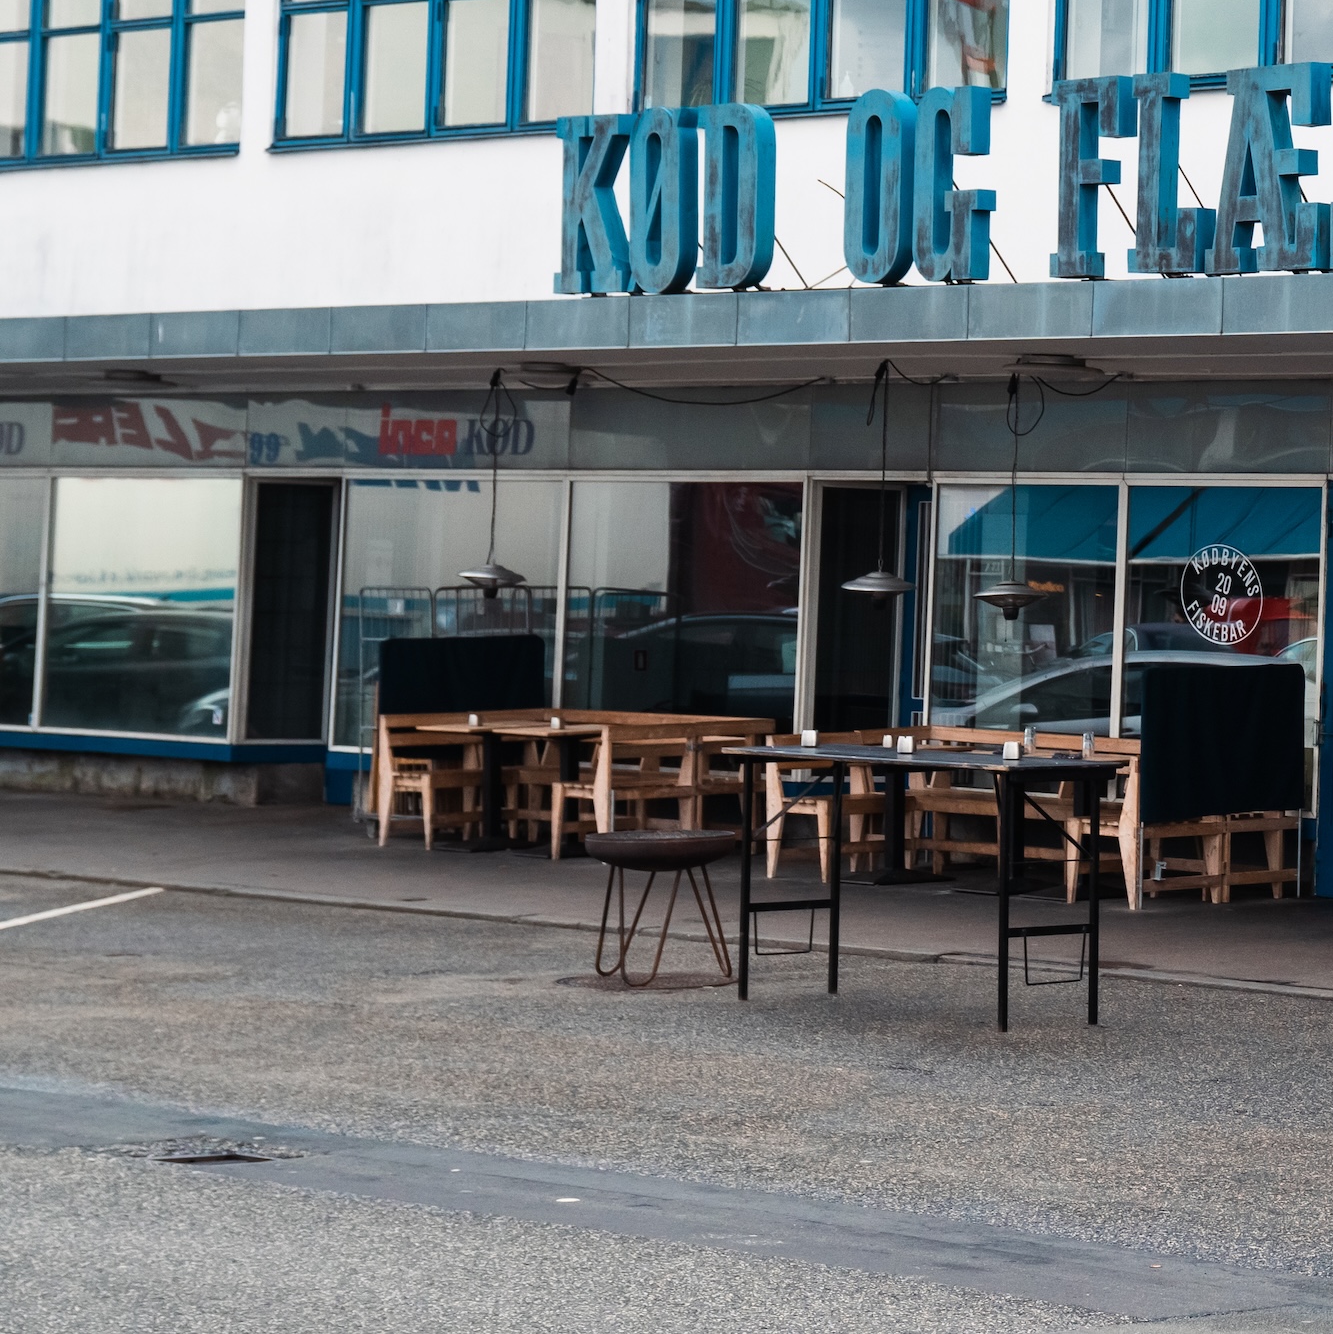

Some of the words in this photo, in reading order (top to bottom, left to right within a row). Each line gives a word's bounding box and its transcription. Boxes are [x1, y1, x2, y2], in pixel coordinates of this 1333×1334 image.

[553, 103, 775, 294] KØD
[843, 86, 996, 284] OG
[465, 418, 535, 456] KØD
[1191, 547, 1260, 597] KØDBYENS
[1215, 572, 1232, 595] 20
[1187, 600, 1247, 642] FISKEBAR
[1211, 594, 1227, 616] 09
